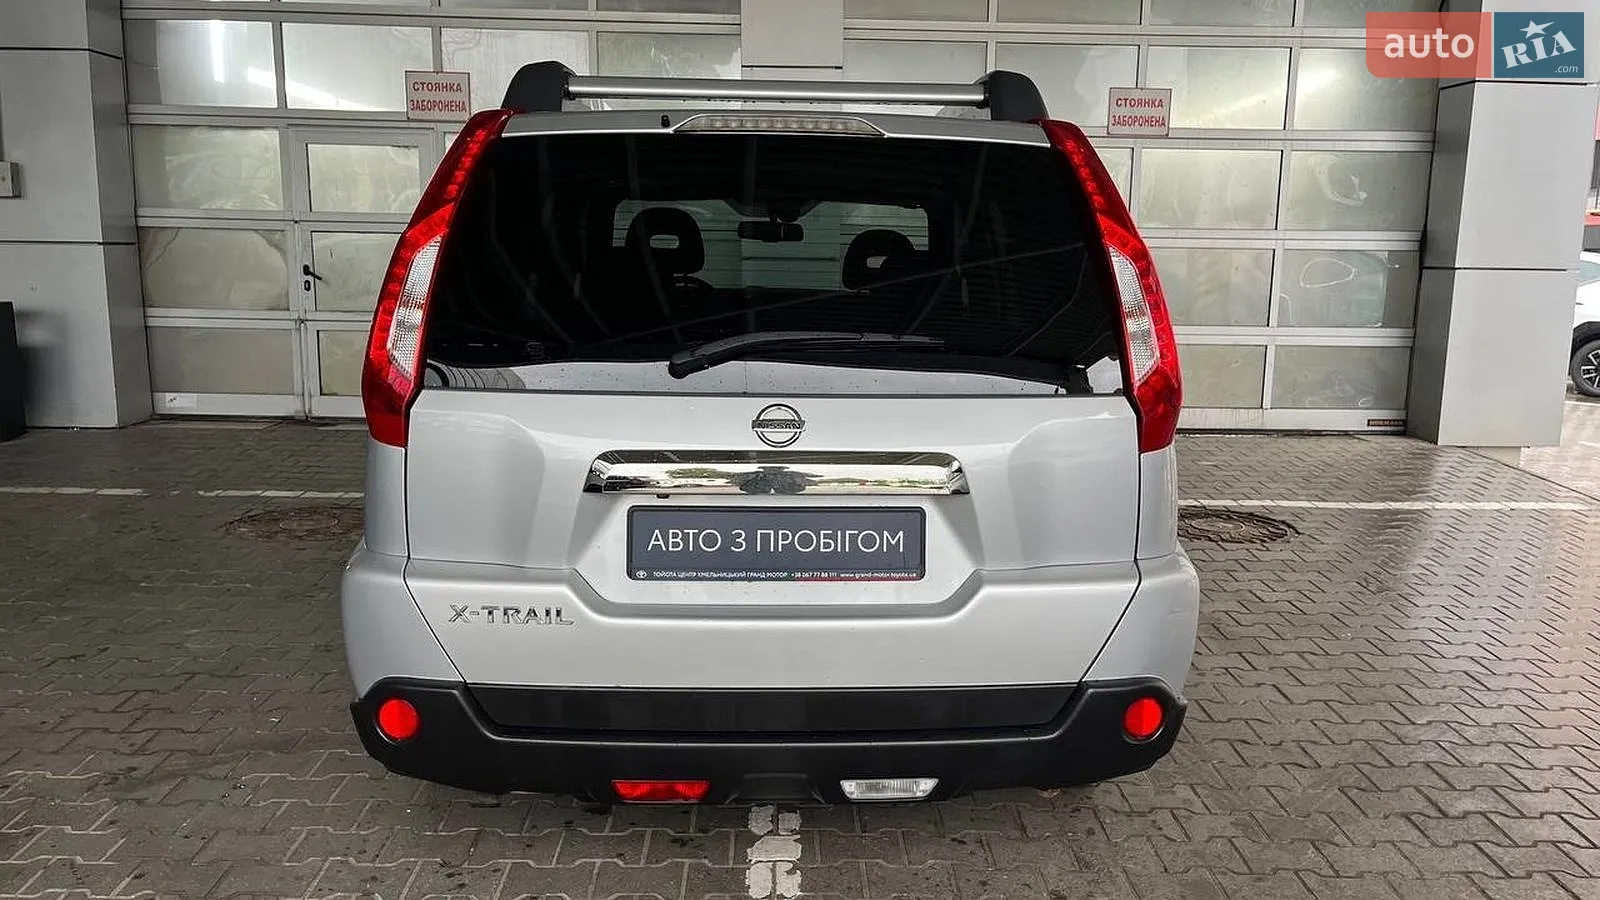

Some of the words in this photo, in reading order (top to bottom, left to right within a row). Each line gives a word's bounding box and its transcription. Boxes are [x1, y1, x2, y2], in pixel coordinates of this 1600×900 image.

[412, 81, 463, 92] СТОЯНКА
[410, 99, 467, 113] ЗАБОРОНЕНА
[1115, 97, 1164, 109] СТОЯНКА
[1111, 114, 1167, 128] ЗАБОРОНЕНА
[755, 420, 801, 430] NISSAN
[647, 529, 722, 552] АВТО
[756, 529, 904, 553] ПРОБІГОМ
[653, 569, 677, 577] ТОЙОТА
[448, 604, 575, 625] X-TRAIL
